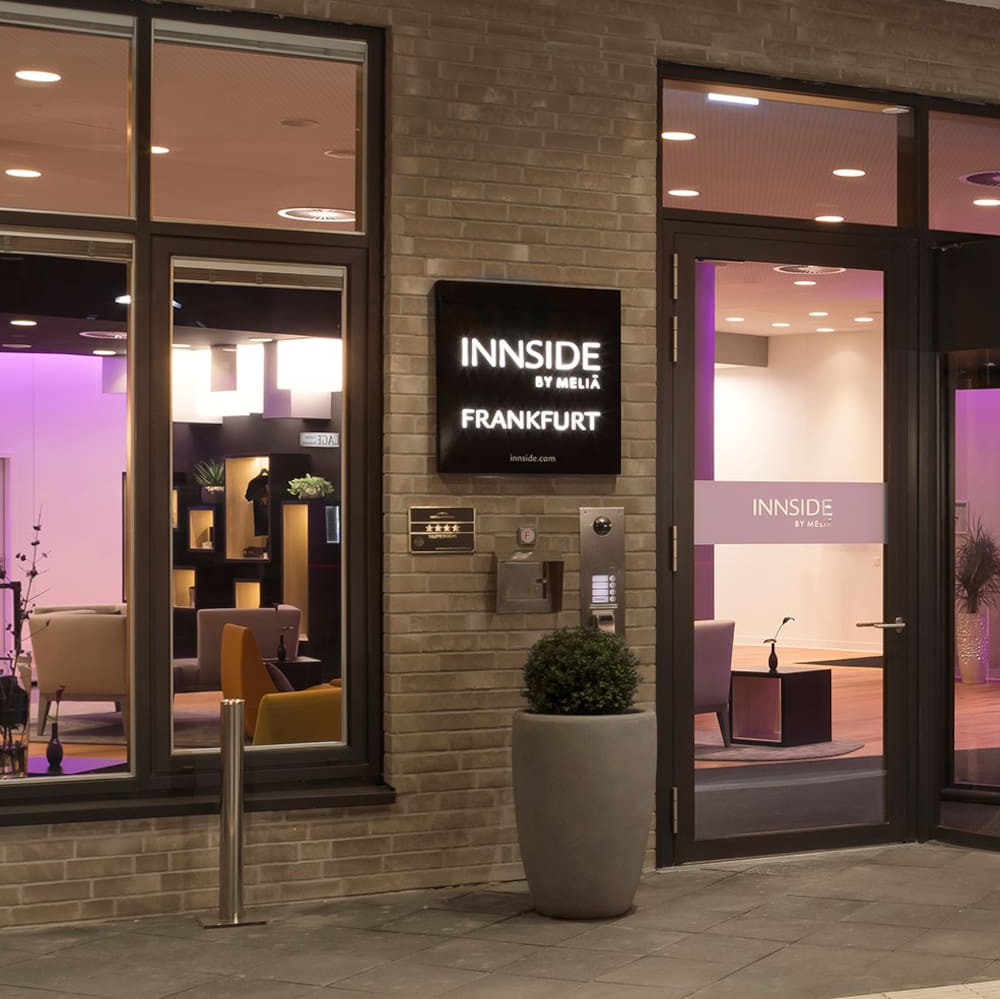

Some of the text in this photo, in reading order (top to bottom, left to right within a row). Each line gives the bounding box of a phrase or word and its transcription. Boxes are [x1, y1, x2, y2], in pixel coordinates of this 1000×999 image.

[461, 337, 601, 371] INNSIDE
[535, 375, 552, 388] BY
[461, 408, 601, 431] FRANKFURT
[510, 453, 556, 463] innside.com
[752, 498, 833, 517] INNSIDE
[794, 520, 804, 528] BY
